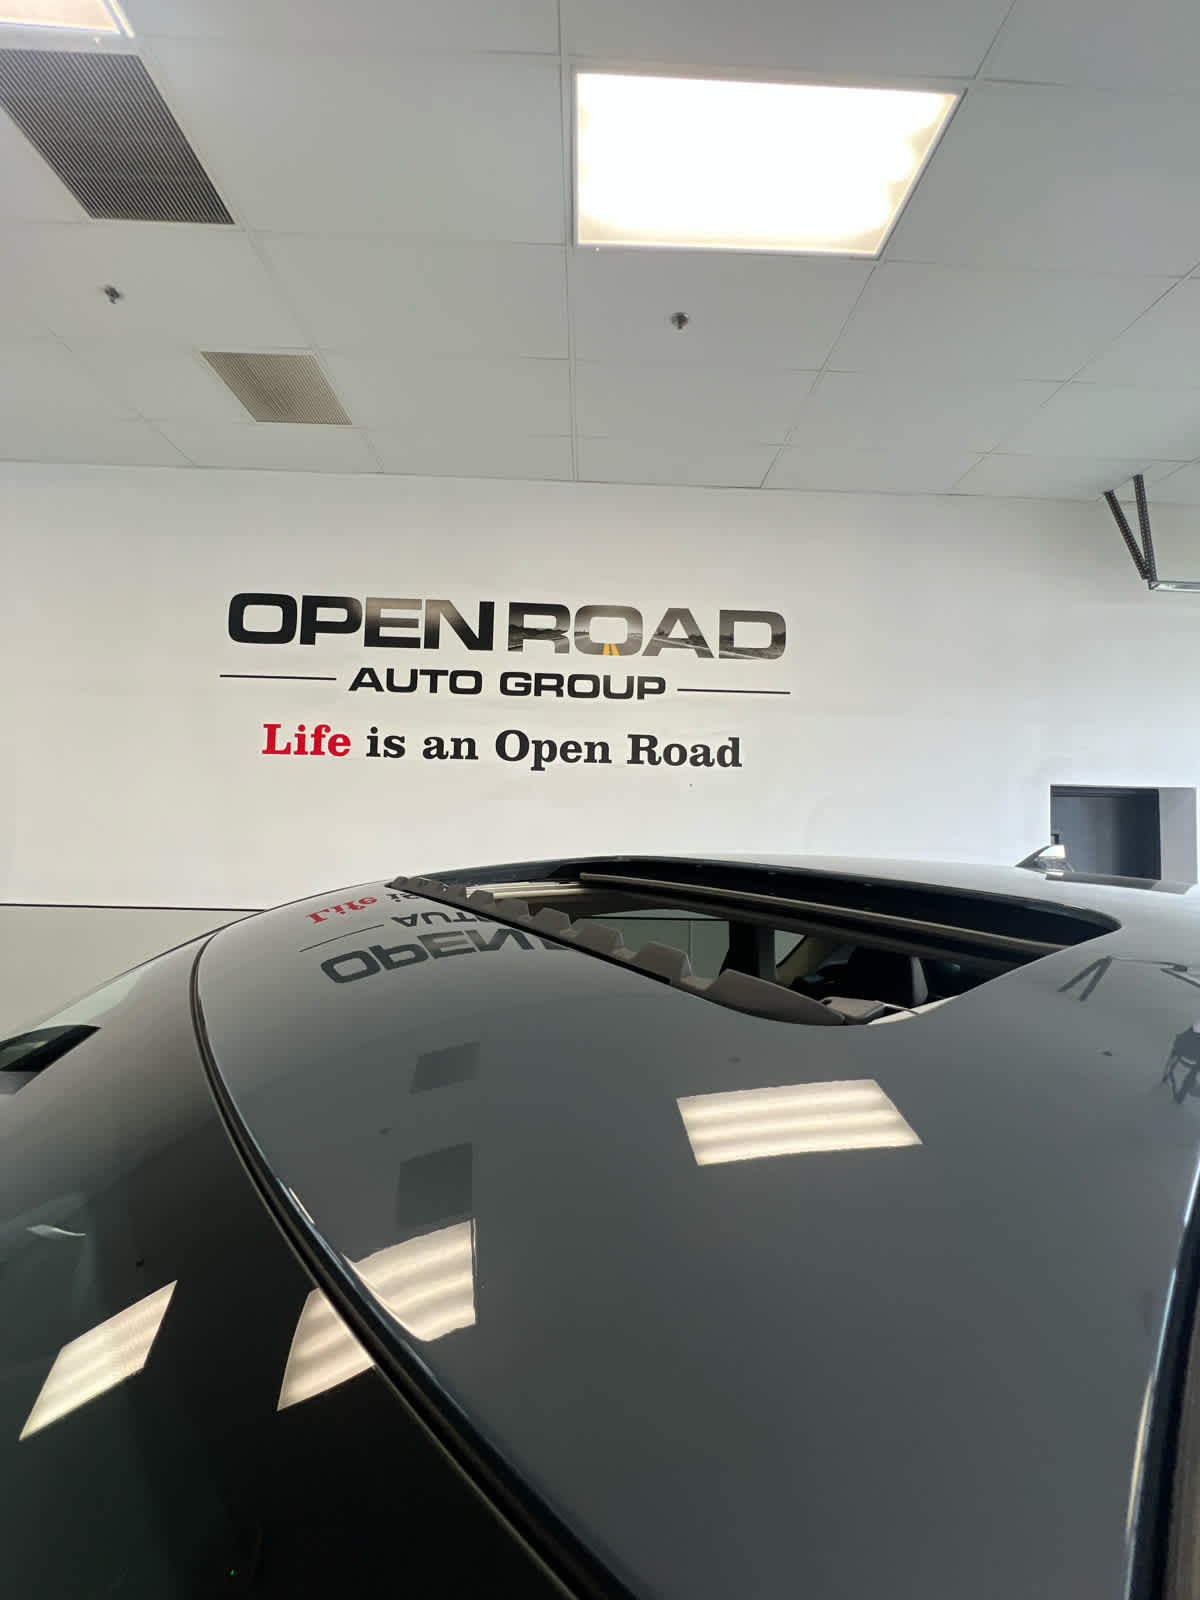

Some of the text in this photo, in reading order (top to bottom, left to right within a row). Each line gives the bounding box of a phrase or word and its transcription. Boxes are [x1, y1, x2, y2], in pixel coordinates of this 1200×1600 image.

[228, 593, 787, 660] OPEN ROAD
[348, 667, 666, 700] AUTO GROUP
[262, 723, 743, 771] Life is an Open Road
